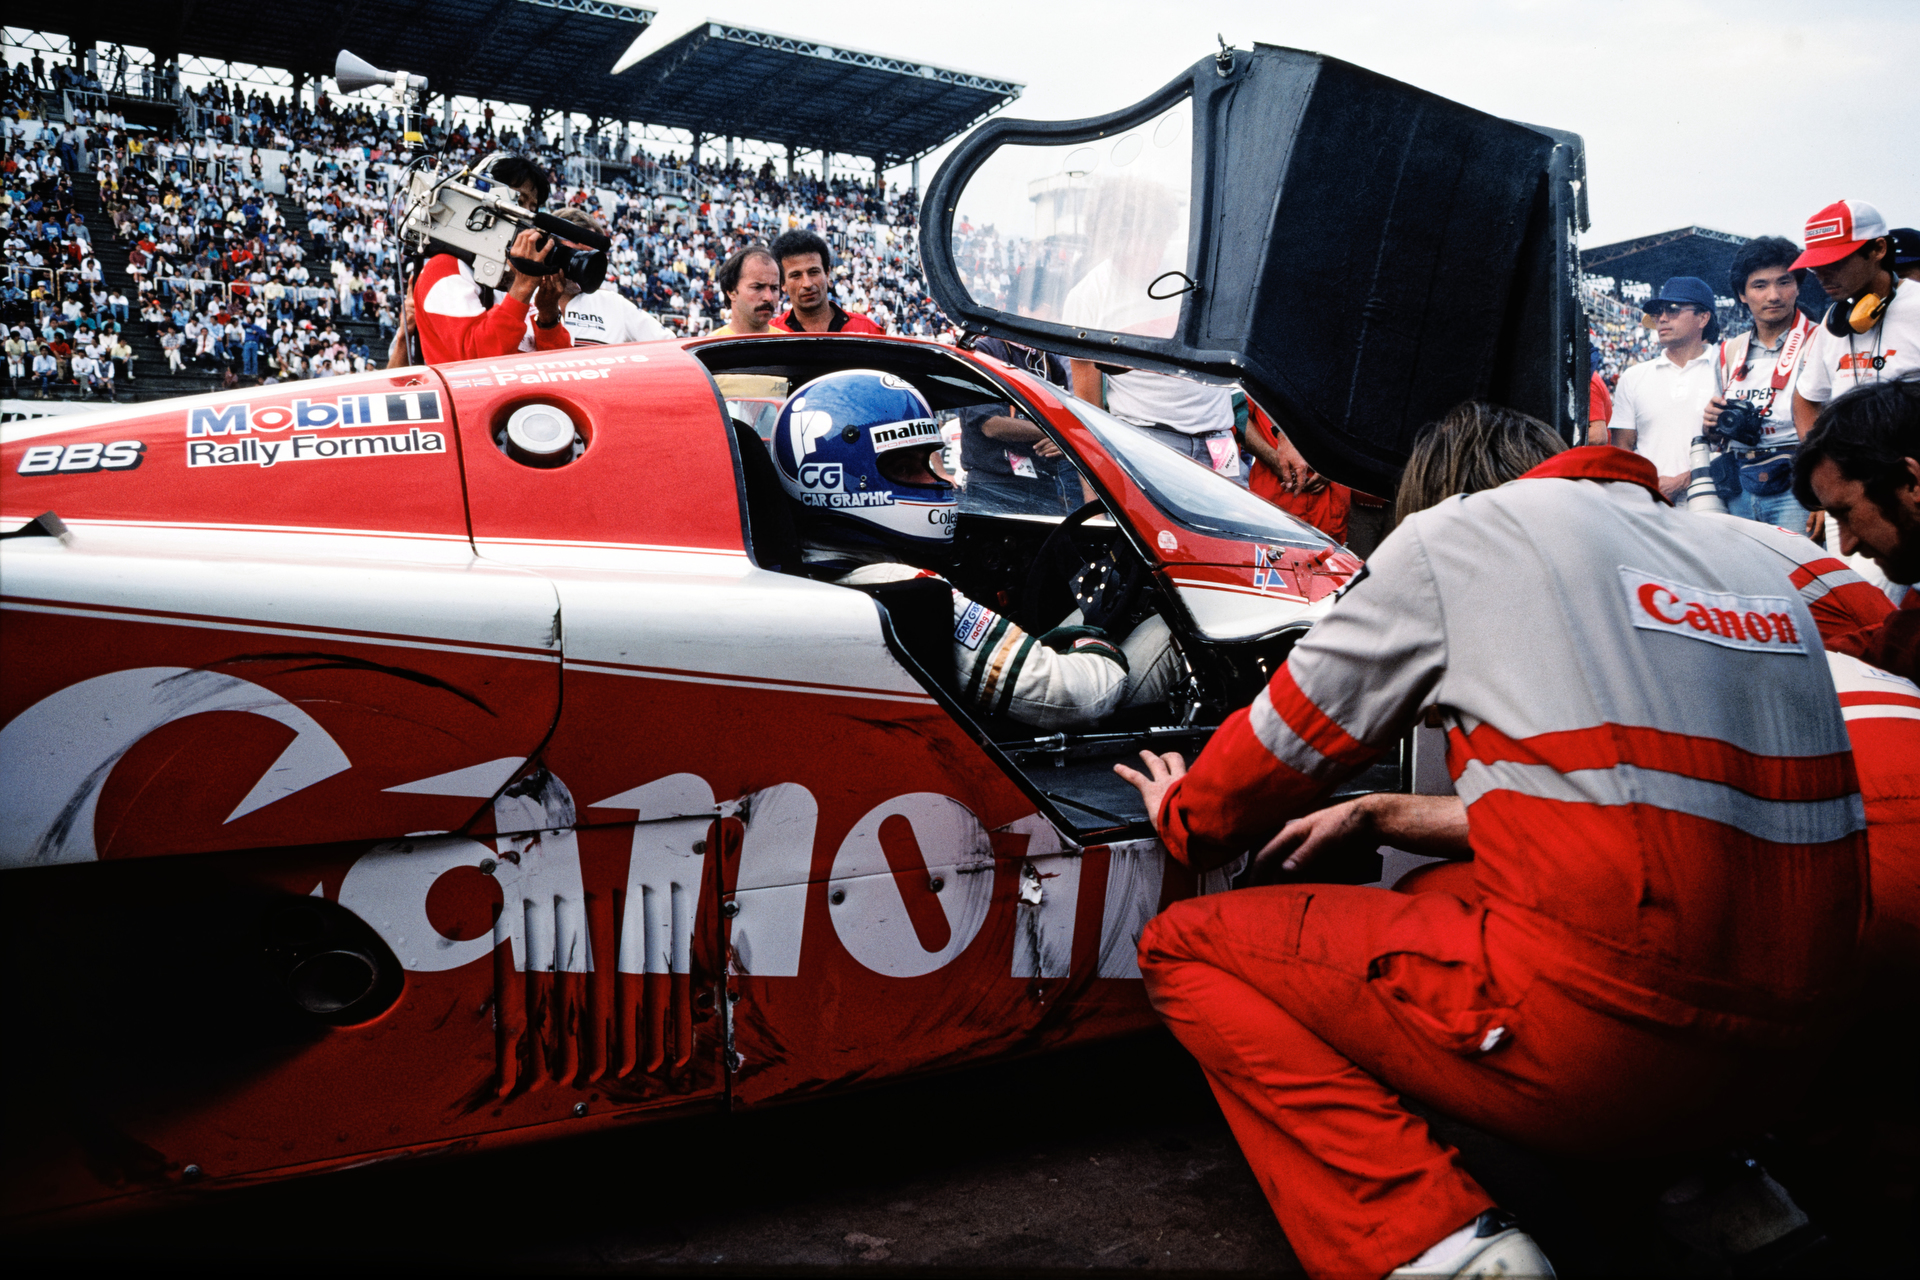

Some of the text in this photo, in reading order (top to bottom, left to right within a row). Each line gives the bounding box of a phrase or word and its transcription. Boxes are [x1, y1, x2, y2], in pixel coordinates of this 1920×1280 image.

[489, 354, 650, 374] Lammers
[1780, 333, 1801, 367] Canon
[495, 368, 611, 386] Palmer
[191, 396, 371, 434] Mobil
[17, 440, 146, 477] BBS
[190, 429, 442, 466] Rally Formula
[800, 466, 841, 489] CG
[802, 490, 894, 507] CAR GRAPHIC
[971, 616, 990, 640] racing
[1637, 583, 1799, 643] Canon
[0, 666, 1166, 980] Canon
